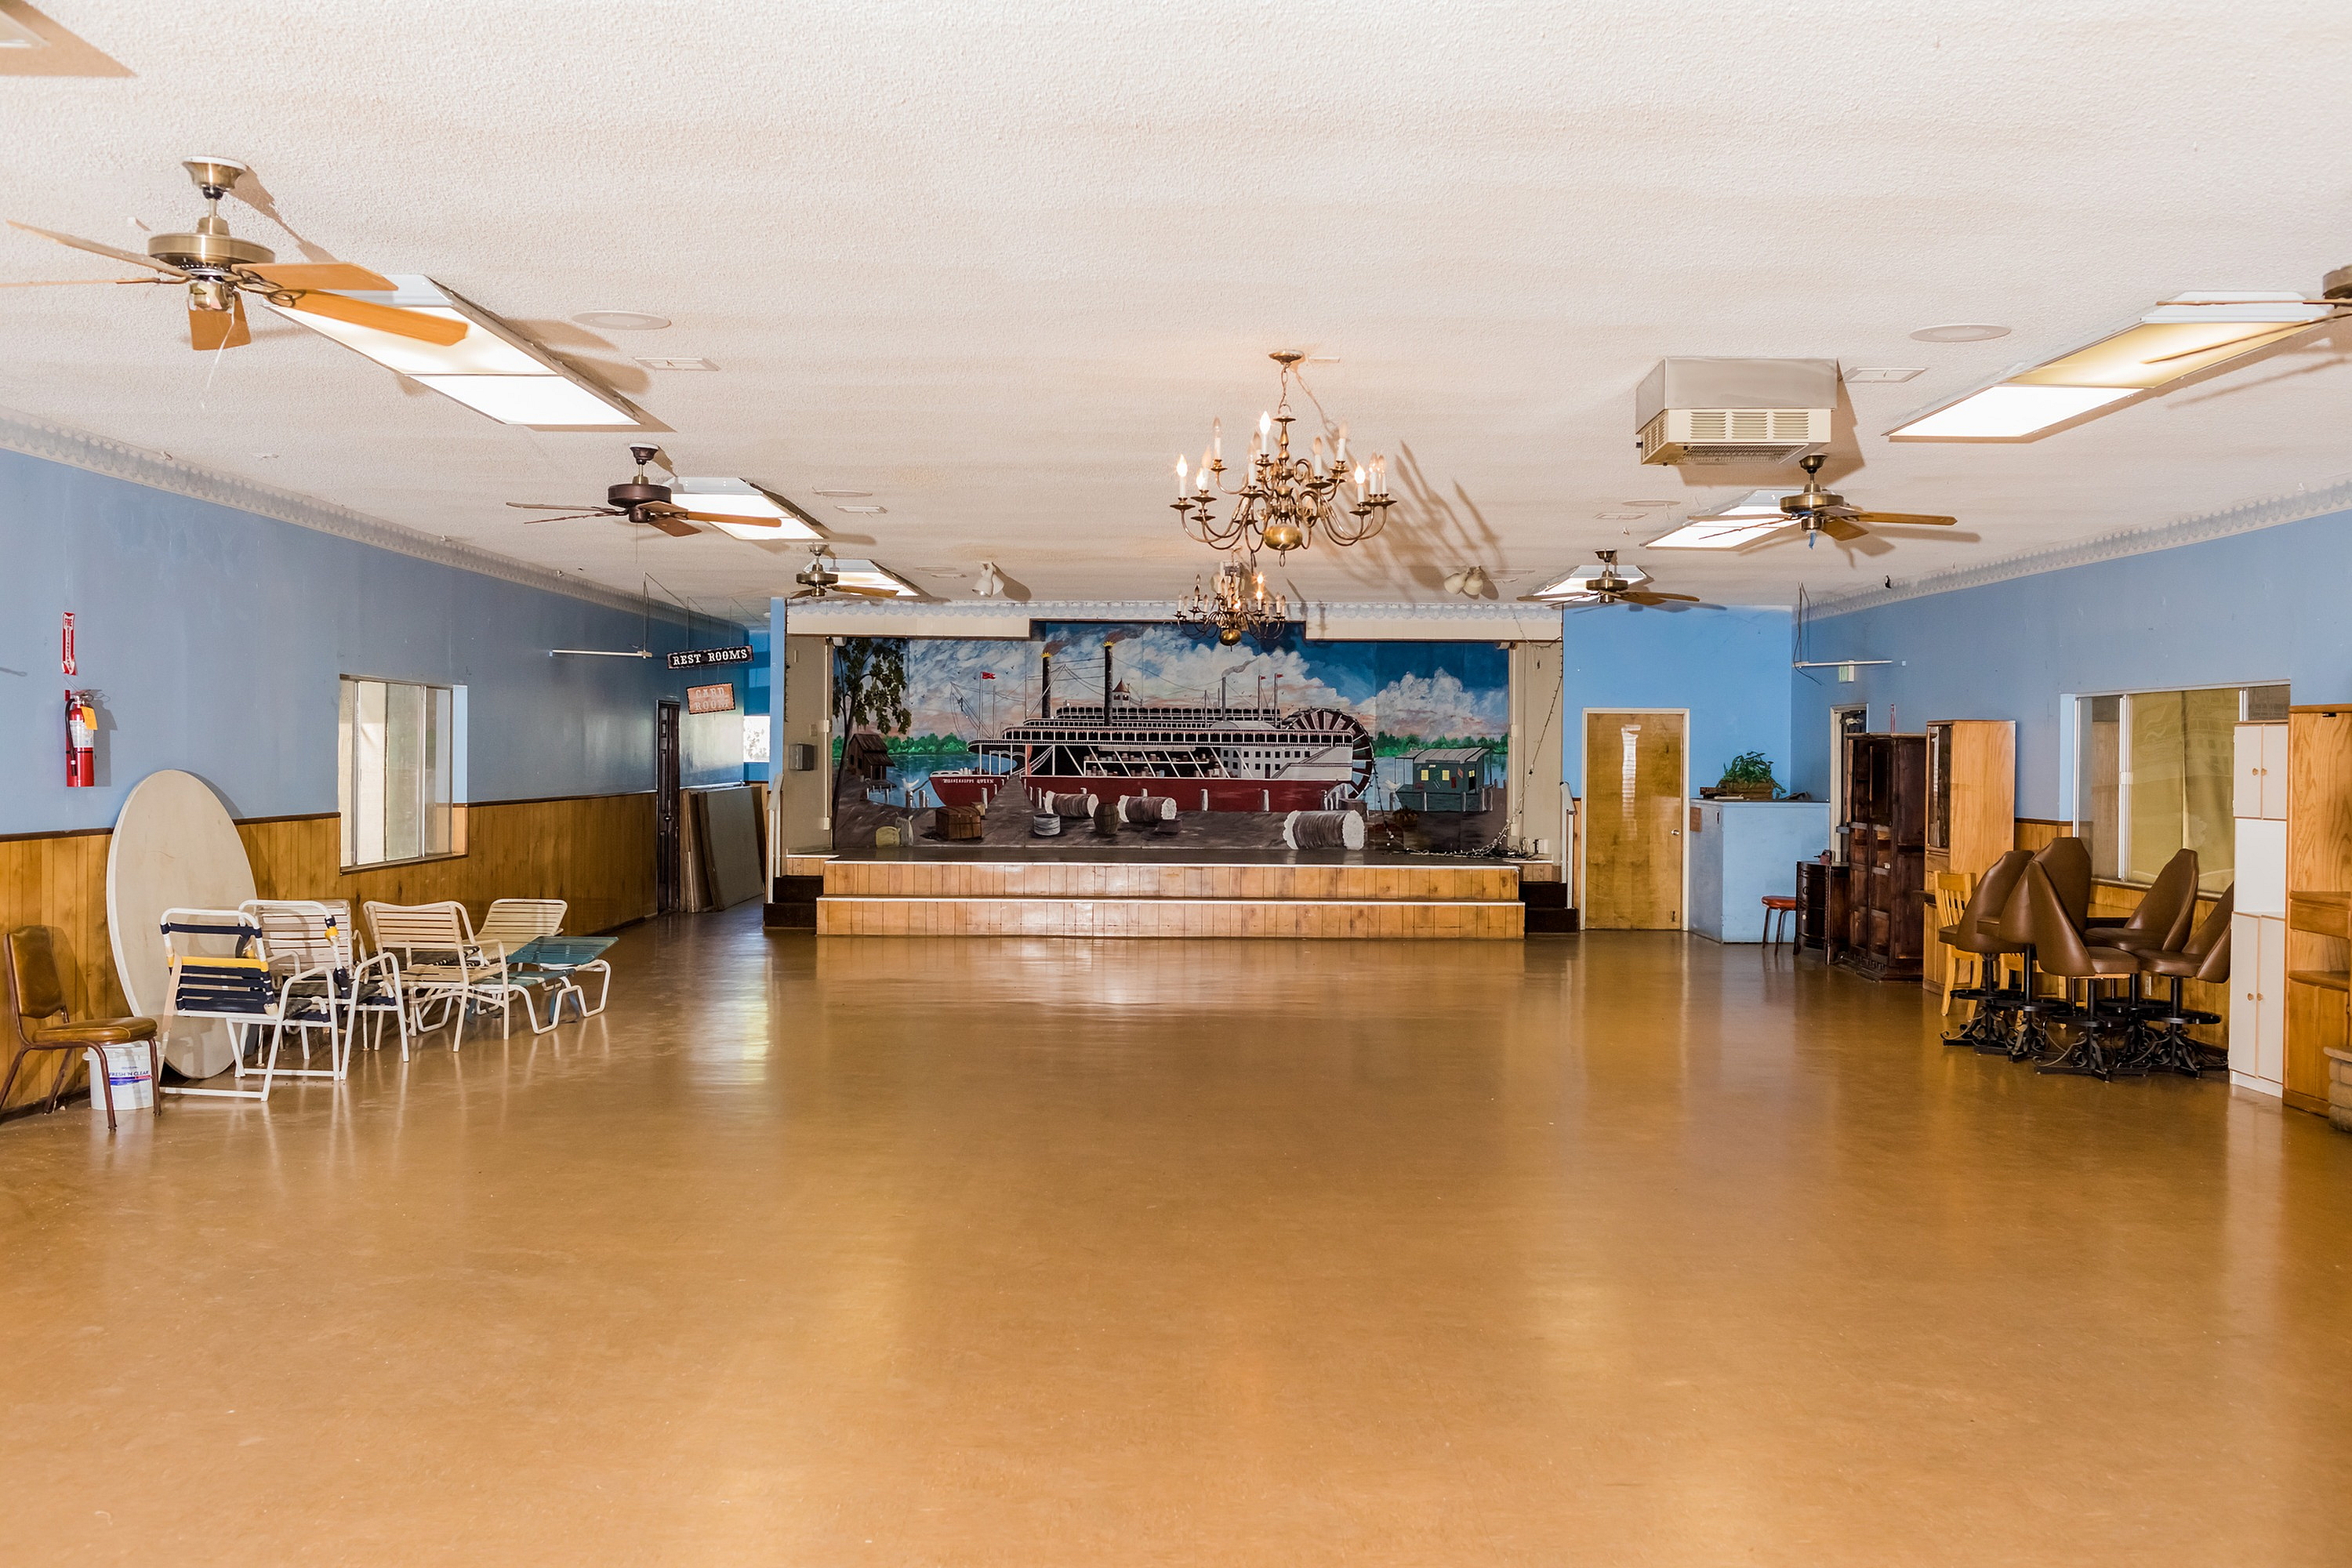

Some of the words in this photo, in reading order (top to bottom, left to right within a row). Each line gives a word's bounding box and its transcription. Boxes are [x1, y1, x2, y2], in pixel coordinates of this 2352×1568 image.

[673, 654, 701, 666] REST
[708, 649, 747, 662] ROOMS
[695, 688, 724, 698] CARD
[695, 699, 728, 710] ROOM
